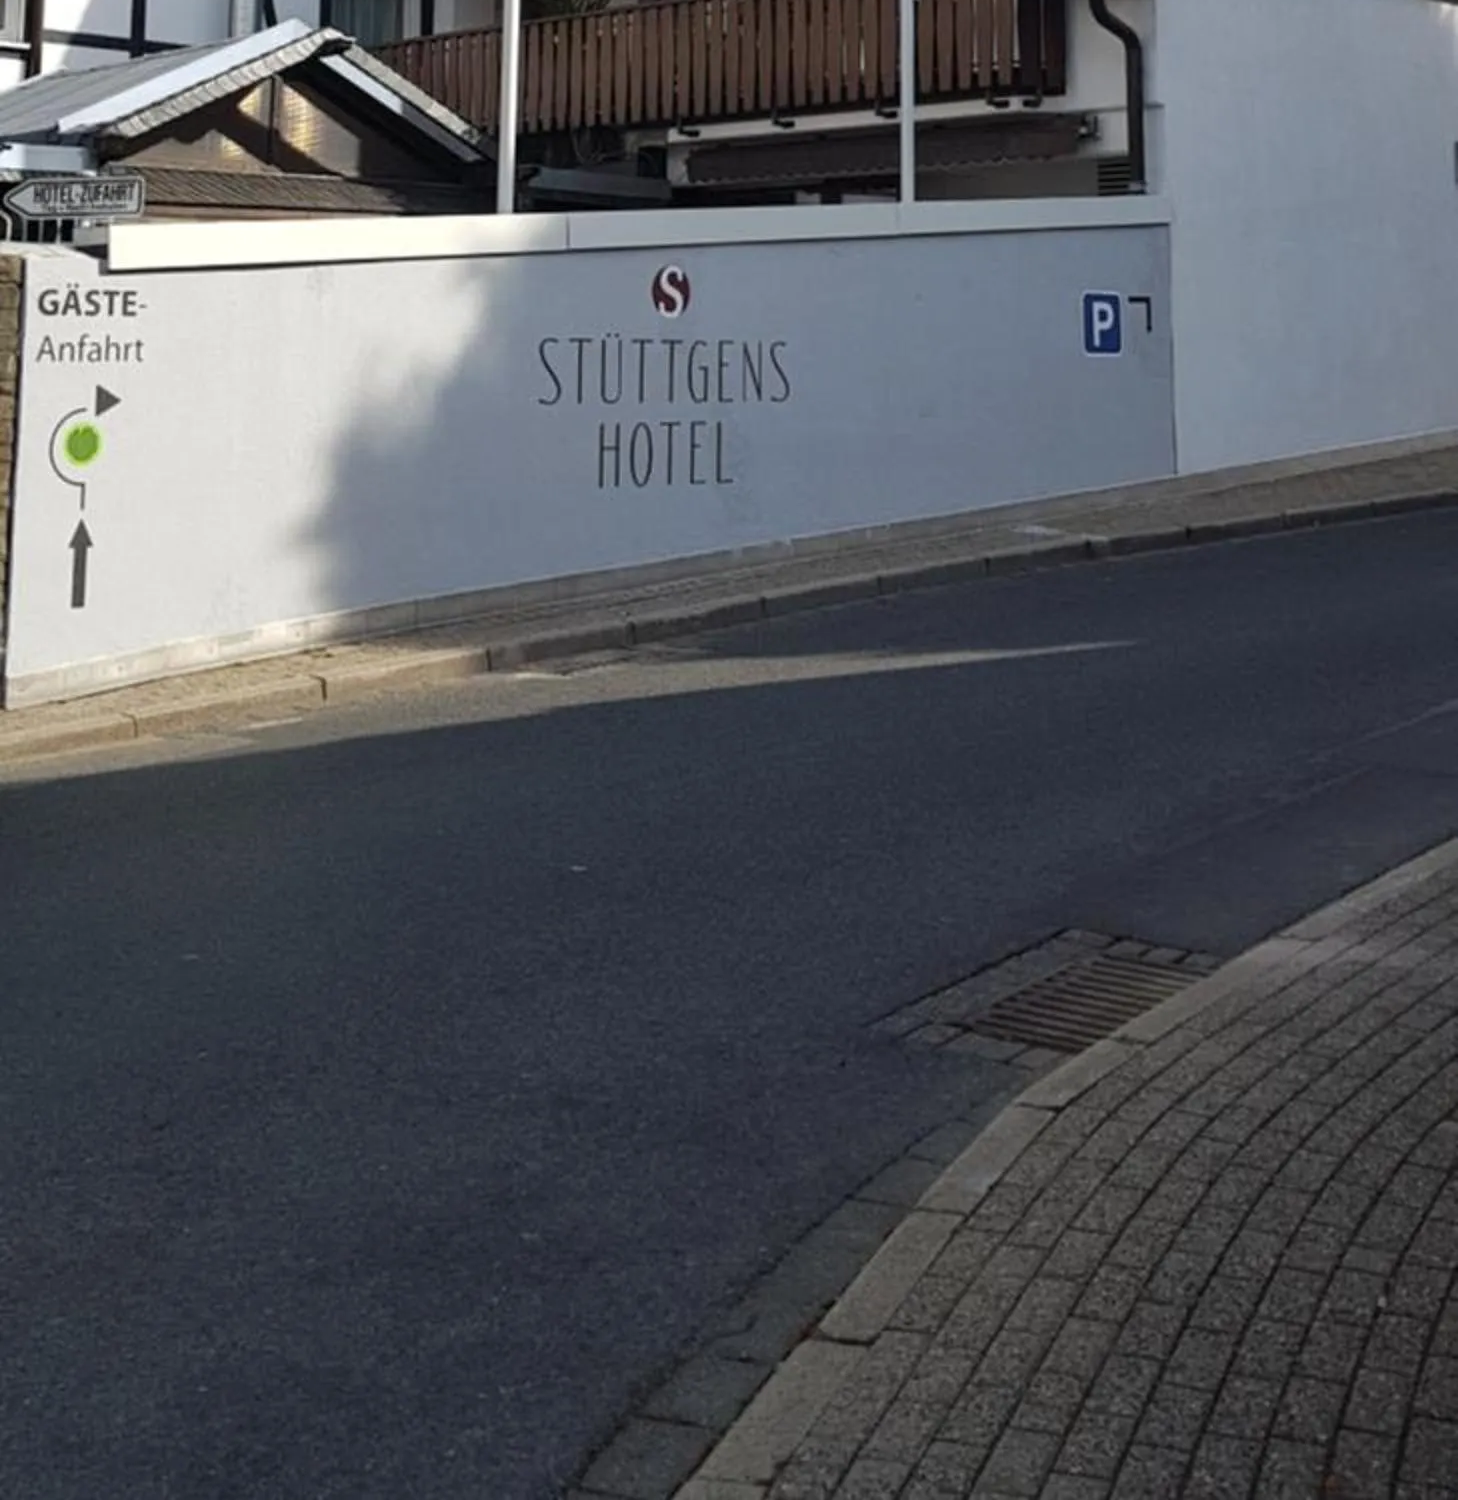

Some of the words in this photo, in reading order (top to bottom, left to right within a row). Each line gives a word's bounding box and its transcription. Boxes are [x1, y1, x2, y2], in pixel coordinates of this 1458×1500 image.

[37, 282, 147, 317] GÄSTE-
[35, 332, 144, 363] Anfahrt
[1092, 301, 1114, 348] P
[537, 332, 791, 406] STÜTTGENS
[598, 420, 734, 489] HOTEL
